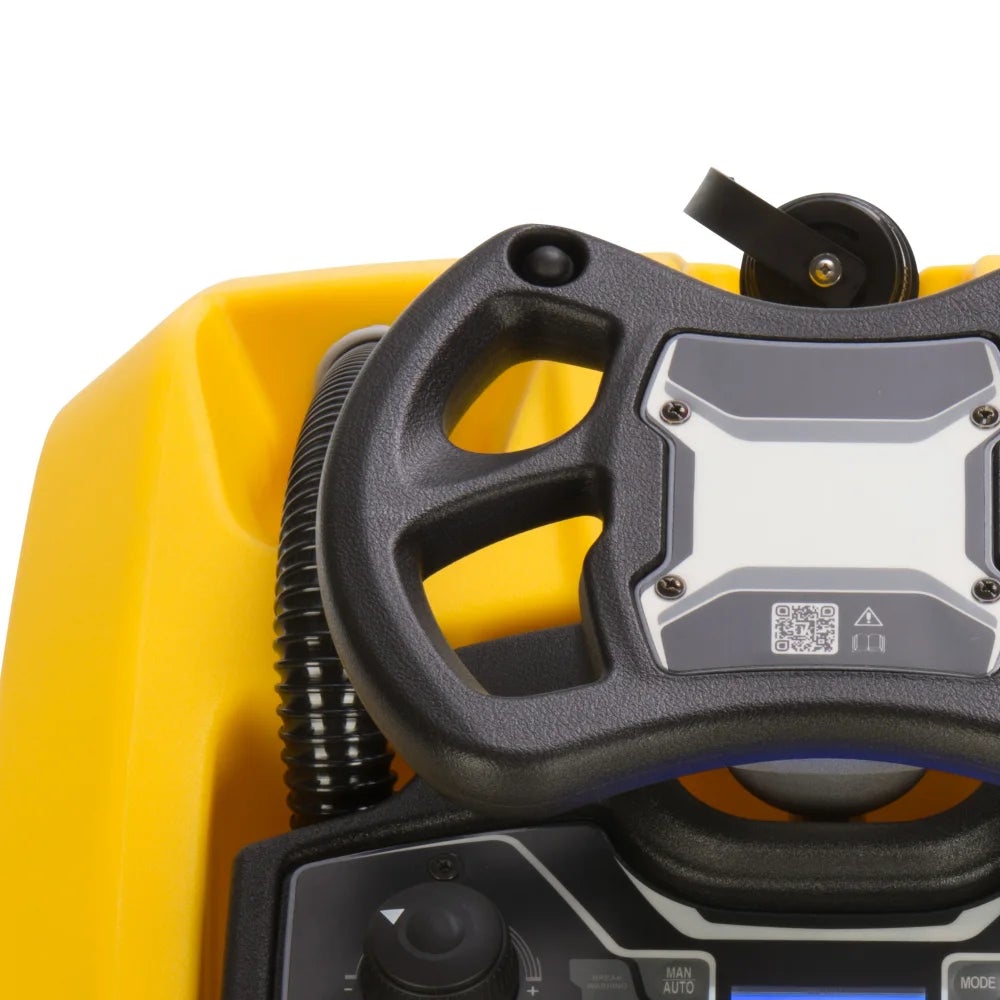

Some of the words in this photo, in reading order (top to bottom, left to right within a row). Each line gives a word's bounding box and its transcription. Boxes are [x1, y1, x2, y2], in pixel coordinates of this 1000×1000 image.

[666, 967, 692, 979] MAN
[663, 981, 695, 994] AUTO
[960, 976, 997, 989] MODE
